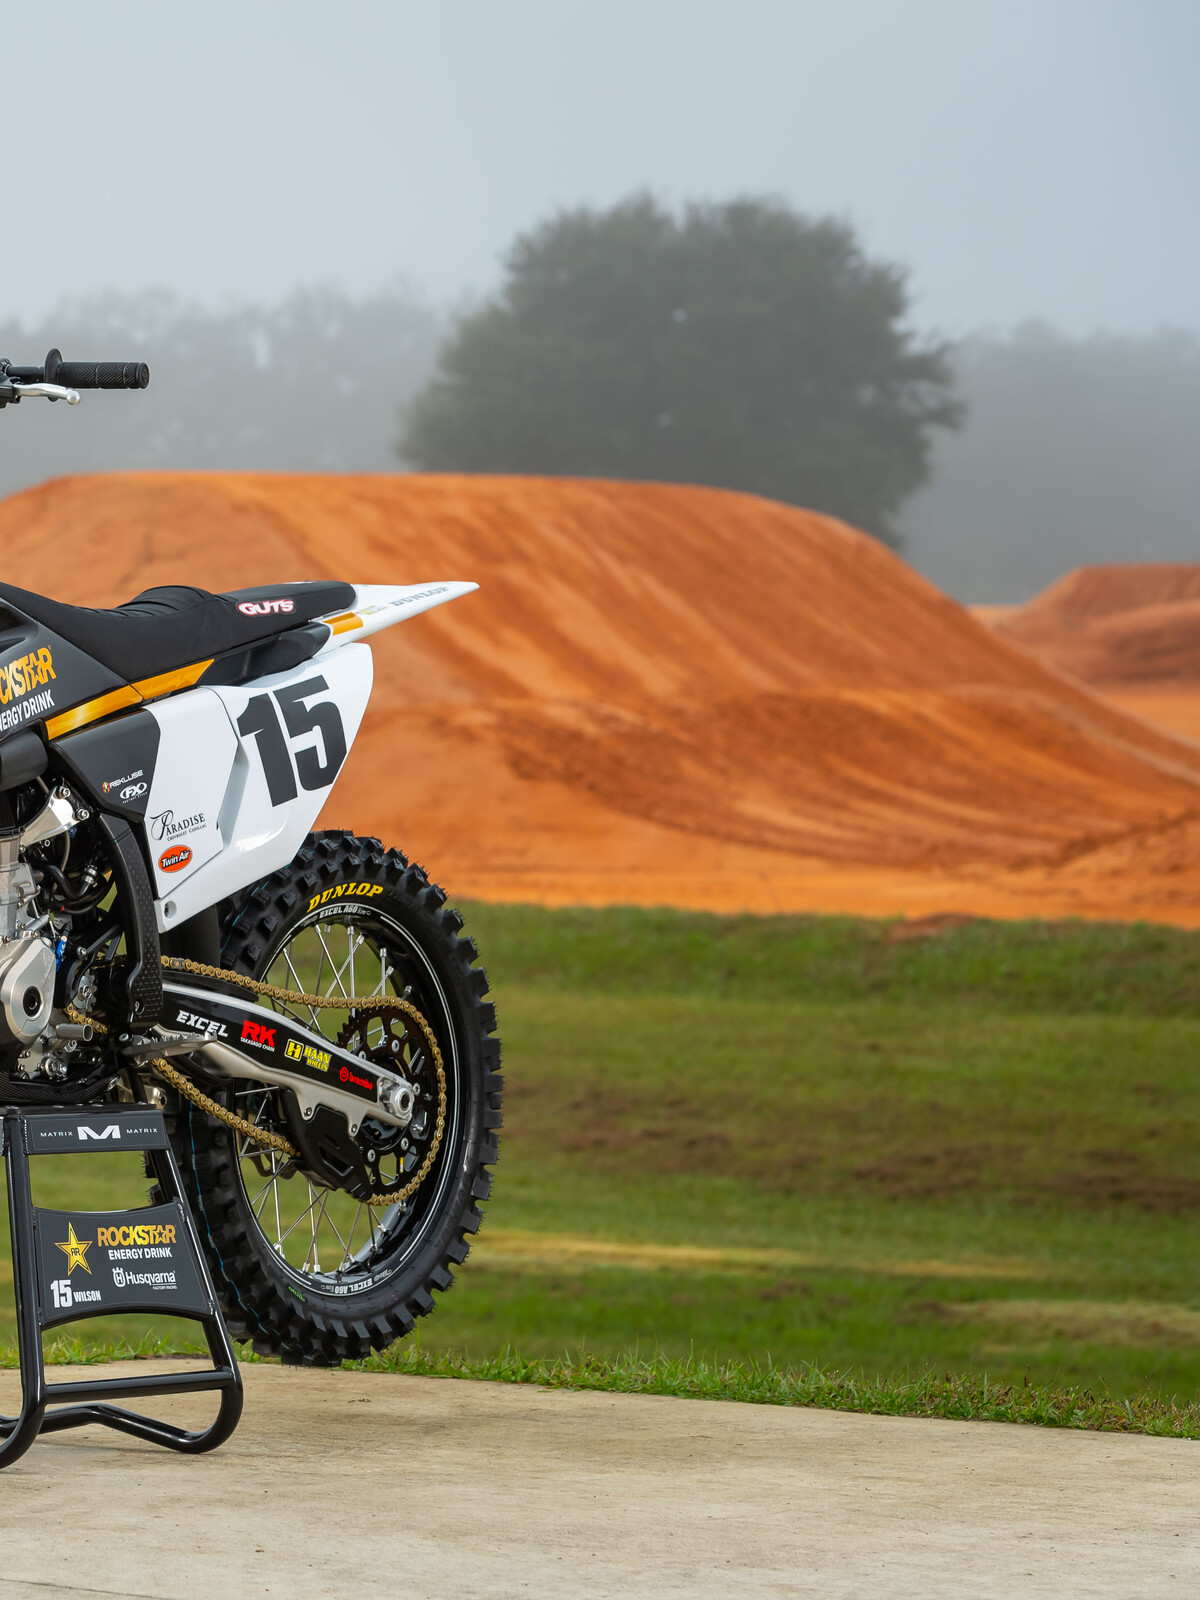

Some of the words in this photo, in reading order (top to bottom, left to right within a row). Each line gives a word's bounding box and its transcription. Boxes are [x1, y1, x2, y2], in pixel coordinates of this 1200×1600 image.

[389, 586, 449, 607] DUNLOP
[237, 599, 295, 616] GUTS
[23, 689, 55, 720] DRINK
[236, 674, 348, 807] 15
[109, 769, 144, 788] REKLUSE
[120, 782, 148, 799] FX
[149, 809, 206, 841] PARADISE
[161, 854, 179, 869] Twin
[178, 850, 191, 862] Air
[306, 882, 384, 913] DUNLOP
[319, 905, 343, 919] EXCEL
[176, 1010, 229, 1038] EXCEL
[240, 1019, 277, 1048] RK
[303, 1045, 332, 1065] HAAN
[306, 1058, 329, 1072] WHEELS
[349, 1071, 374, 1091] brembo
[97, 1224, 177, 1247] ROCKSTAR
[108, 1249, 145, 1261] ENERGY
[144, 1247, 172, 1259] DRINK
[125, 1271, 177, 1286] Husqvarna
[349, 1278, 373, 1292] EXCEL
[50, 1279, 73, 1309] 15
[73, 1290, 102, 1303] WILSON
